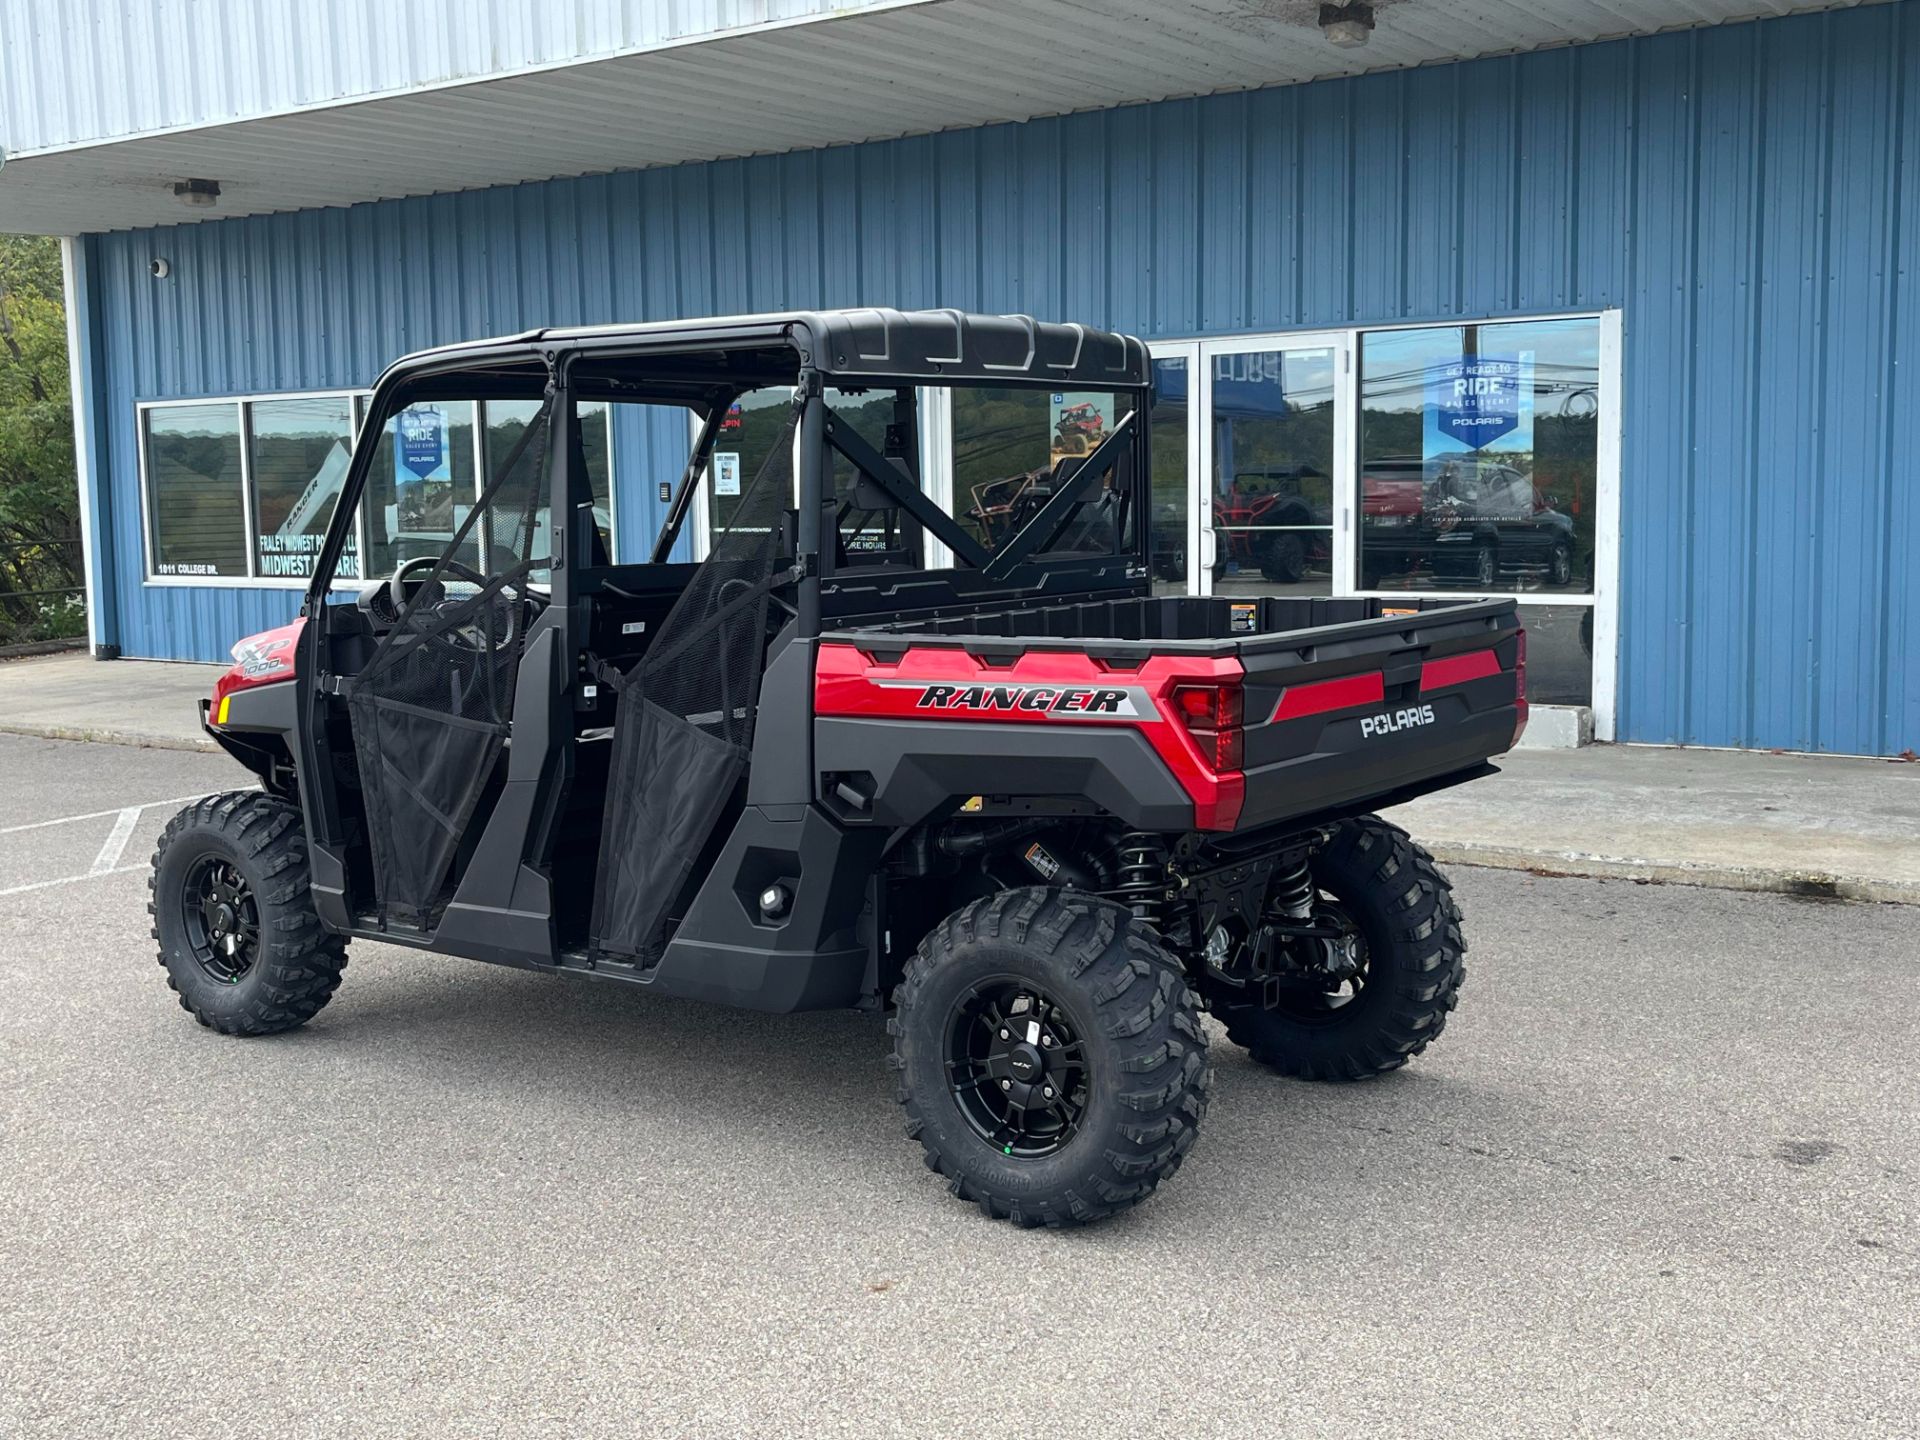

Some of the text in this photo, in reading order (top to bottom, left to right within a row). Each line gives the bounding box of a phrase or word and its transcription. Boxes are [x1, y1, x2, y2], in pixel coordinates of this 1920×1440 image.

[1446, 364, 1511, 376] GET READY TO
[1453, 376, 1504, 398] RIDE
[1445, 398, 1511, 409] SALES EVENT
[1452, 417, 1504, 427] POLARIS
[408, 427, 434, 442] RIDE
[286, 479, 319, 530] RANGER
[259, 534, 284, 552] FRALEY
[285, 534, 315, 552] MIDWEST
[158, 564, 219, 575] 1011 COLLEGE DR.
[261, 554, 311, 576] MIDWEST
[240, 639, 291, 665] XP
[243, 659, 281, 675] 1000
[917, 685, 1129, 713] RANGER
[1360, 704, 1436, 738] POLARIS
